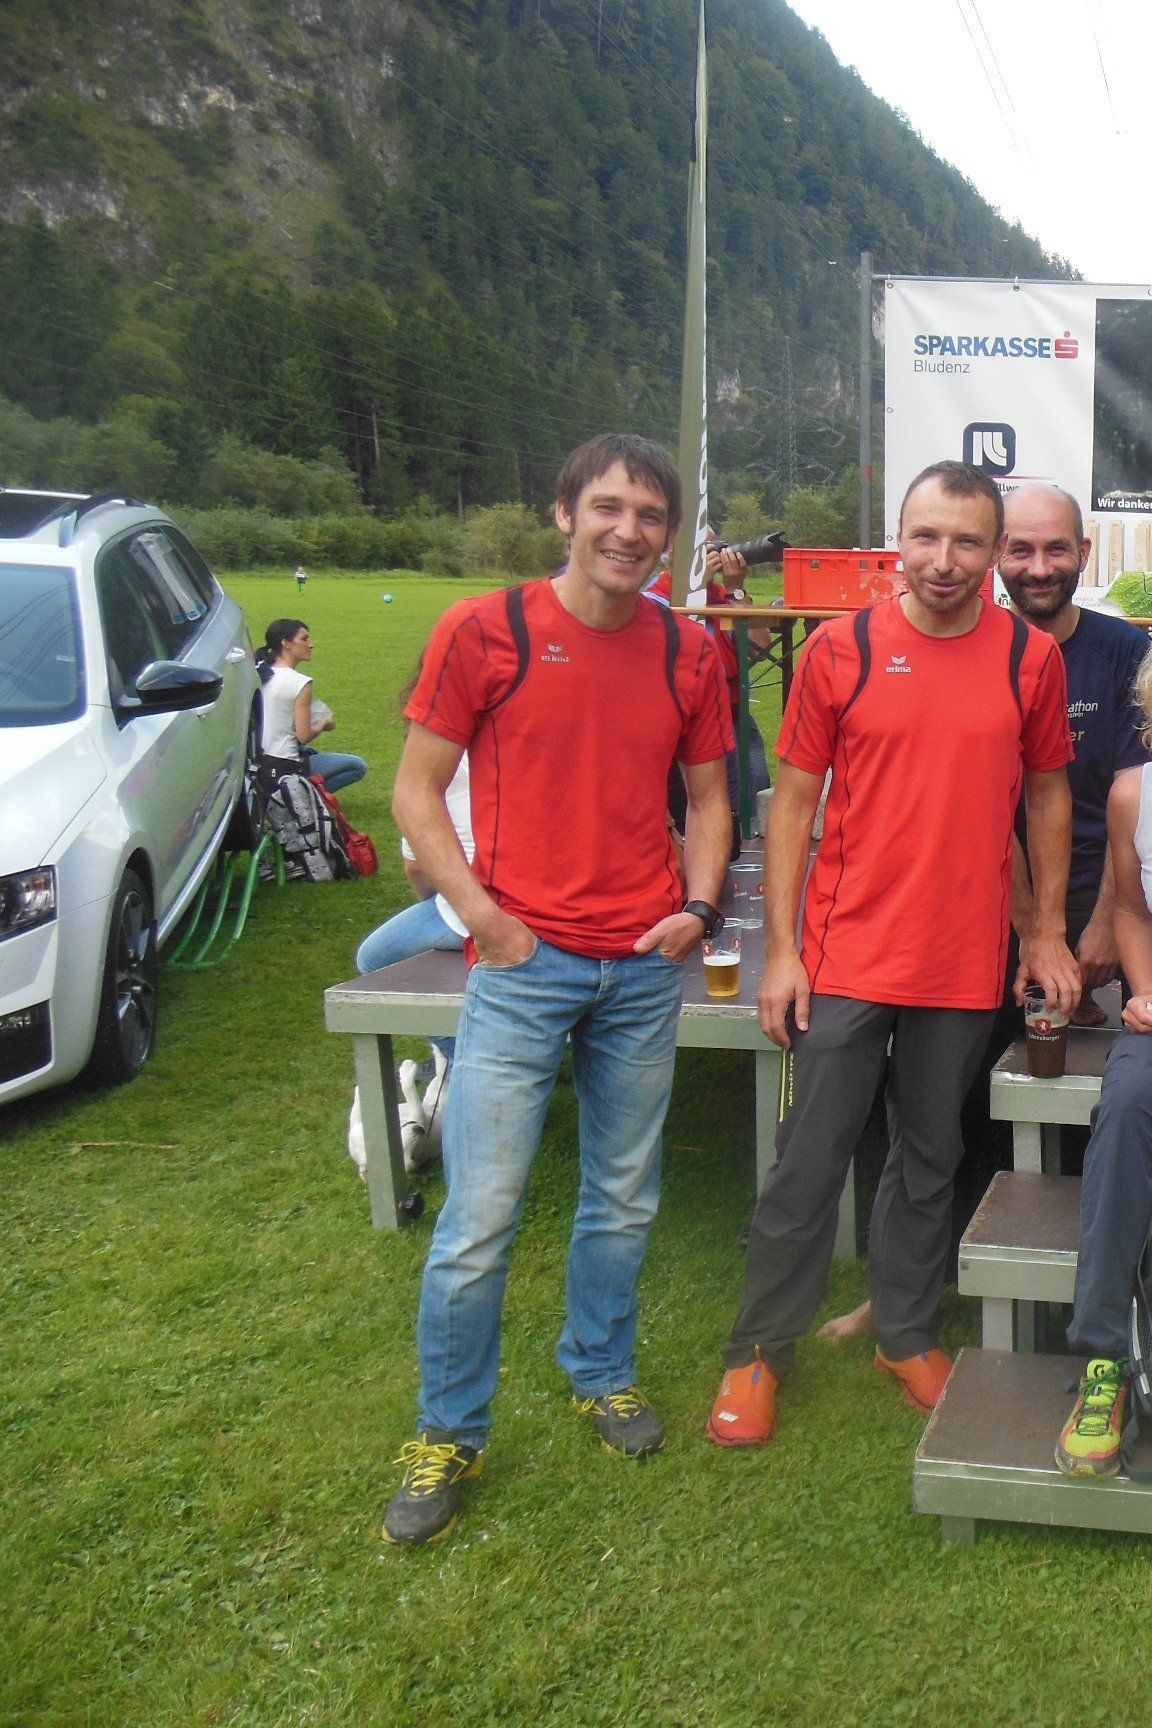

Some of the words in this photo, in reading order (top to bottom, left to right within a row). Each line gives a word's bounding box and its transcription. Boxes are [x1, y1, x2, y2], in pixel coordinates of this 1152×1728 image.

[914, 334, 1051, 359] SPARKASSE
[913, 359, 970, 374] Bludenz
[1097, 497, 1116, 508] Wir
[1067, 699, 1099, 713] athon
